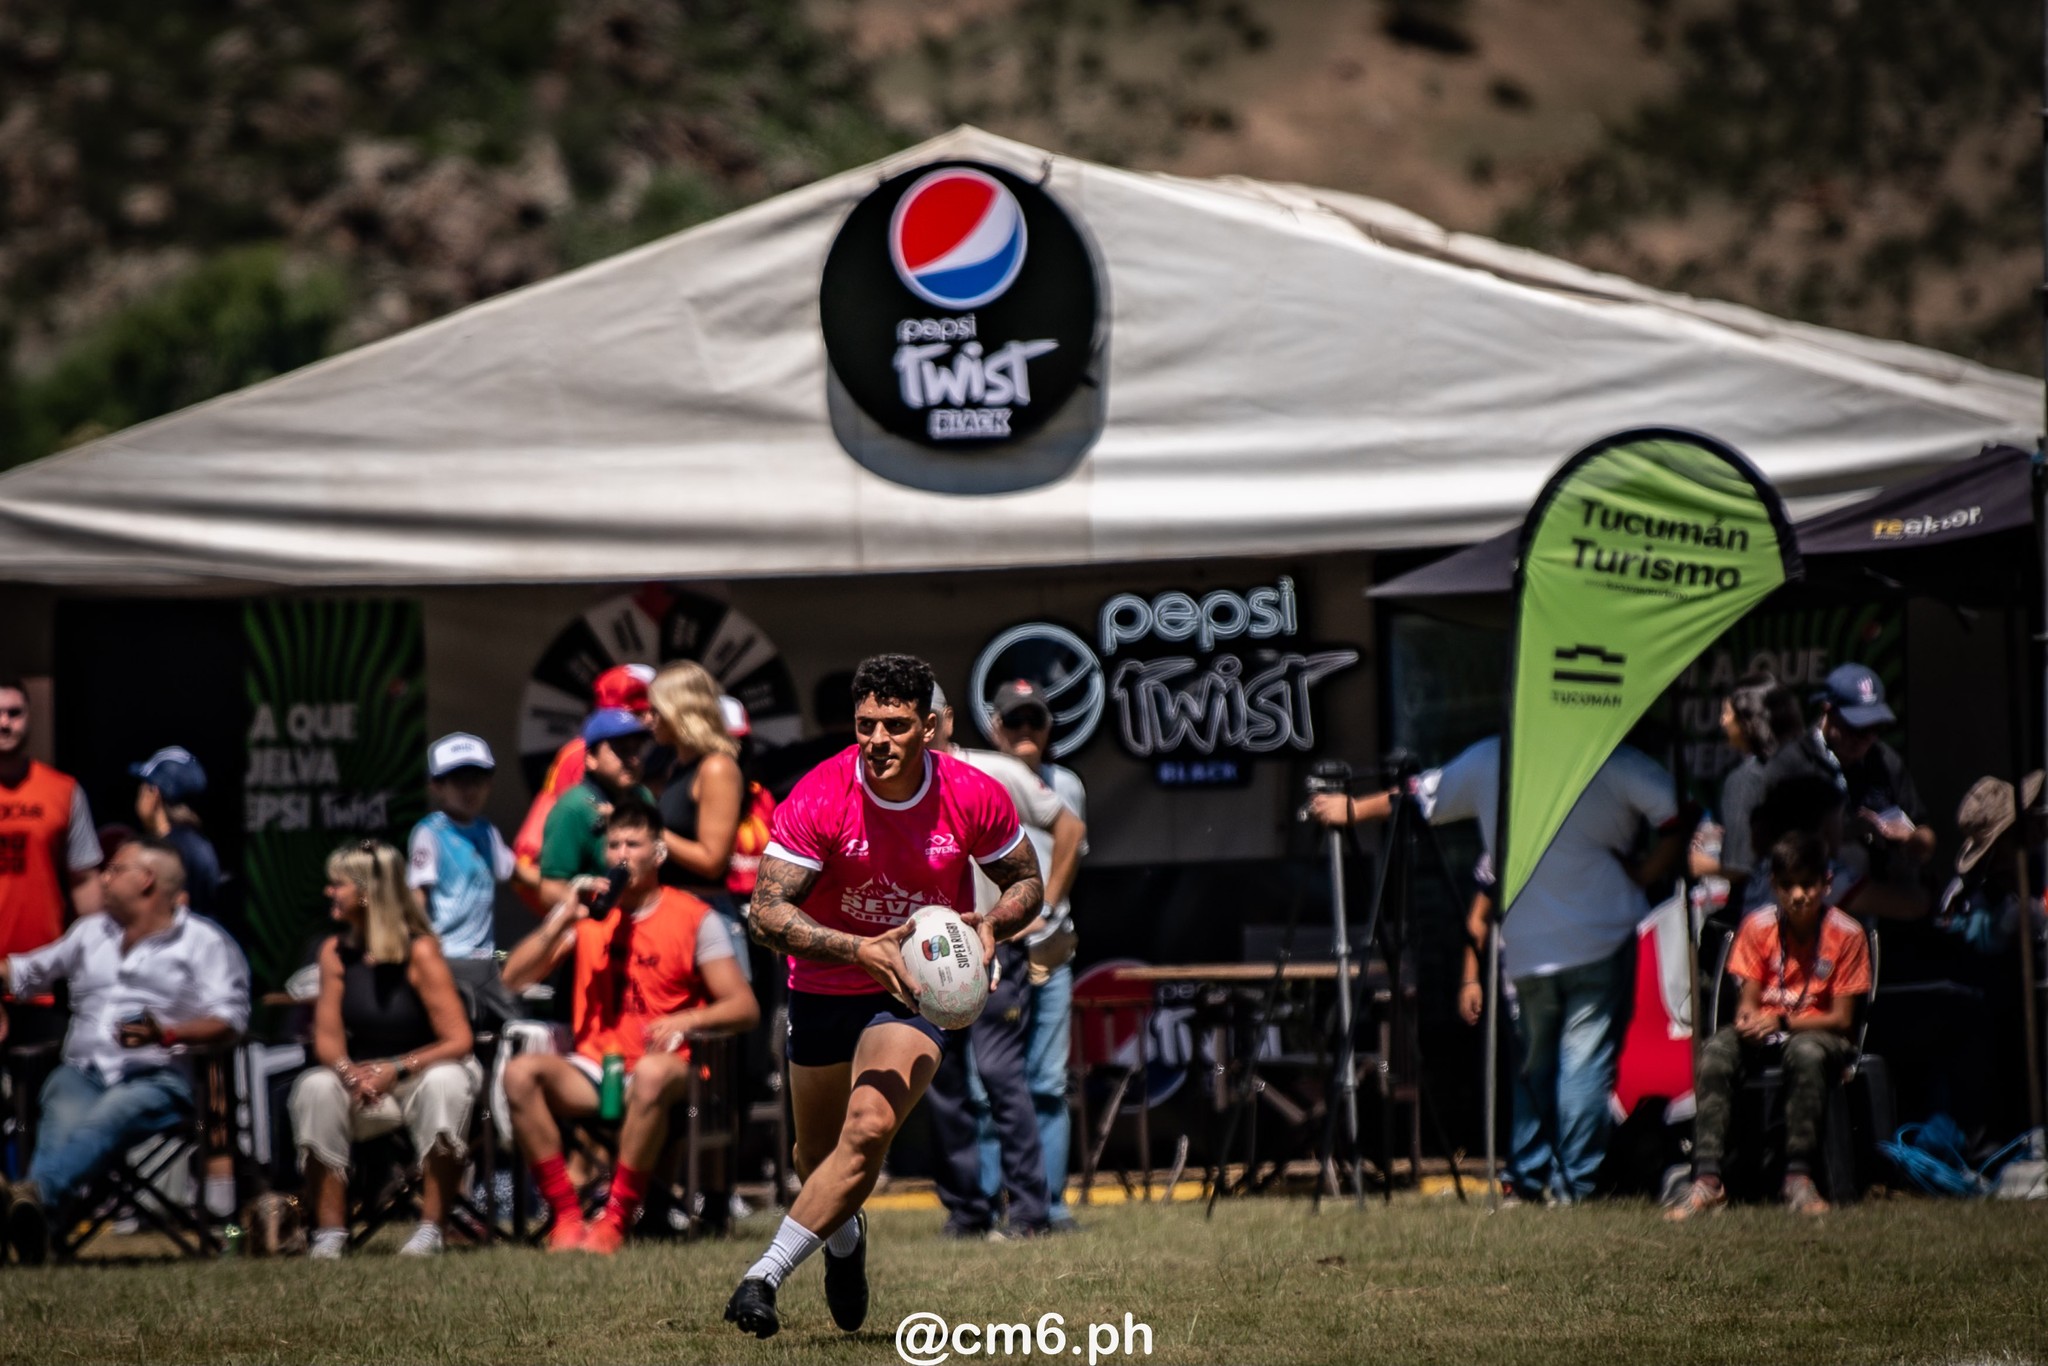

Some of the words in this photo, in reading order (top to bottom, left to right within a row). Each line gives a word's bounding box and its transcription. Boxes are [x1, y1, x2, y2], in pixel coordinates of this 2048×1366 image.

[897, 313, 977, 343] pepsi
[929, 408, 1012, 439] BLACK
[1581, 499, 1749, 551] Tucumán
[1573, 536, 1741, 590] Turismo
[1099, 575, 1298, 655] pepsi
[945, 922, 963, 944] RUGBY
[952, 943, 970, 969] SUPER
